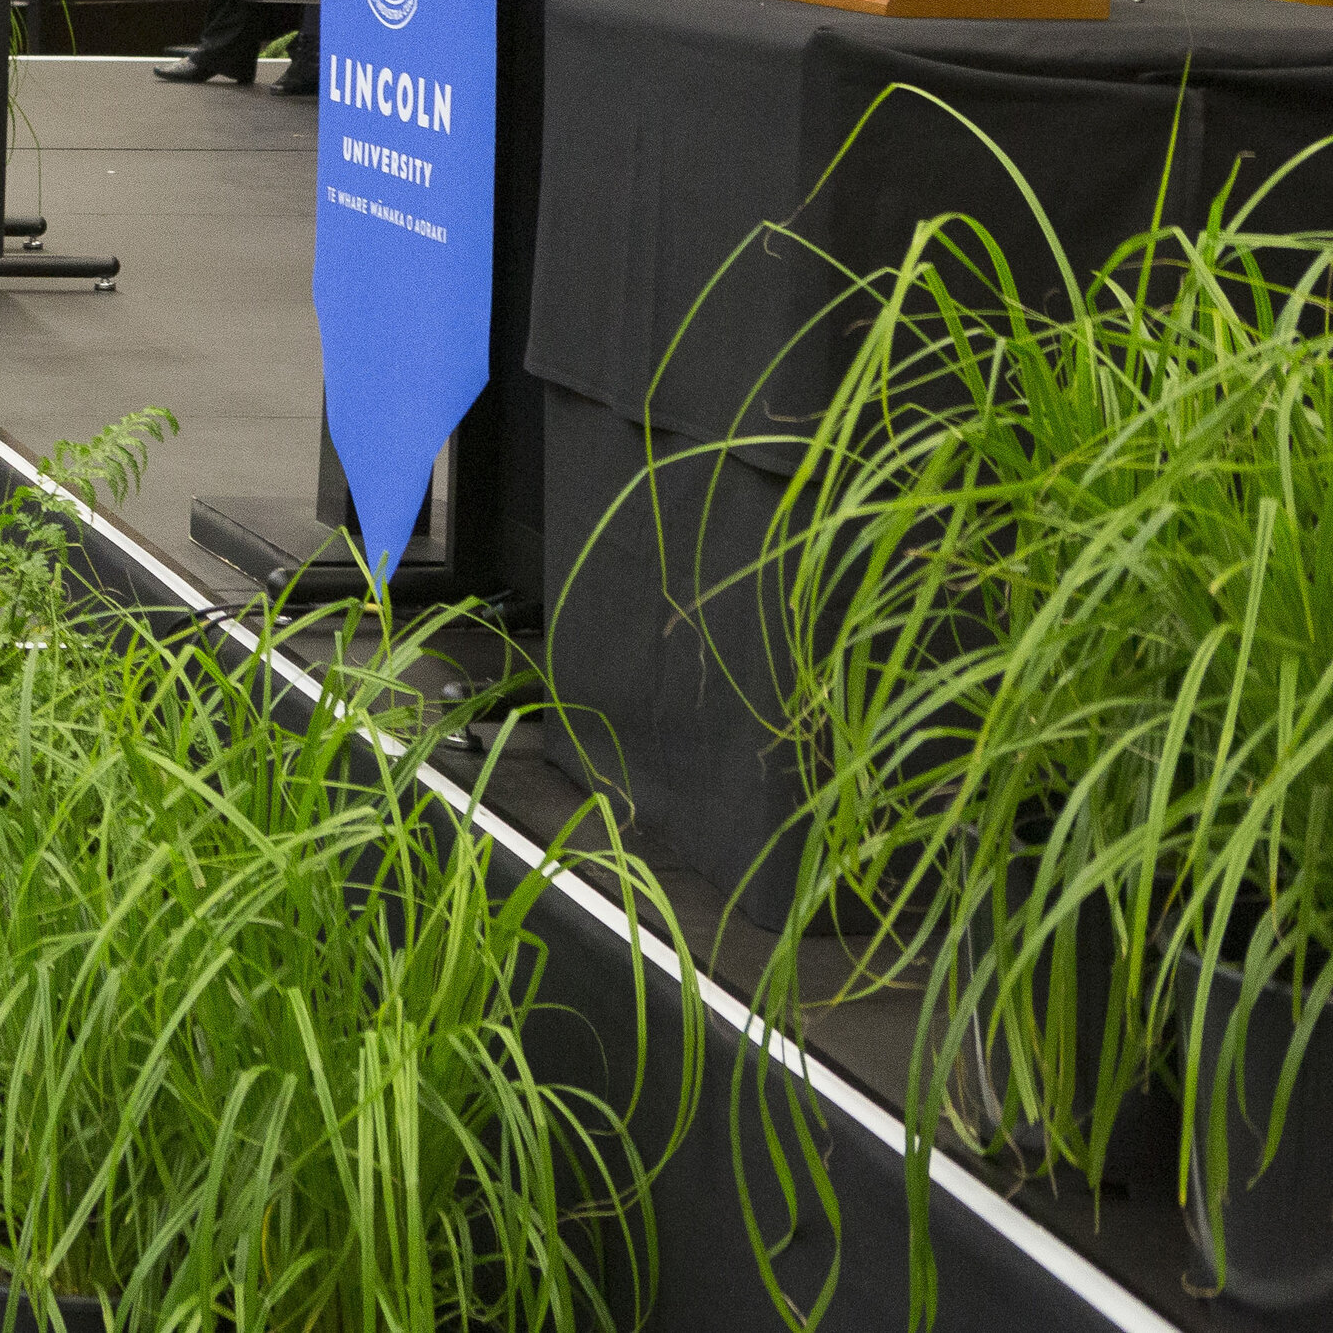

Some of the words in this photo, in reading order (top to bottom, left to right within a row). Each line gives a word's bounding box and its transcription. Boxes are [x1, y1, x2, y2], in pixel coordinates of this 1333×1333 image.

[329, 54, 452, 135] LINCOLN
[342, 136, 433, 188] UNIVERSITY
[326, 186, 337, 203] TE
[338, 190, 368, 214] WHARE
[406, 213, 414, 231] O
[414, 218, 448, 244] AORAKI
